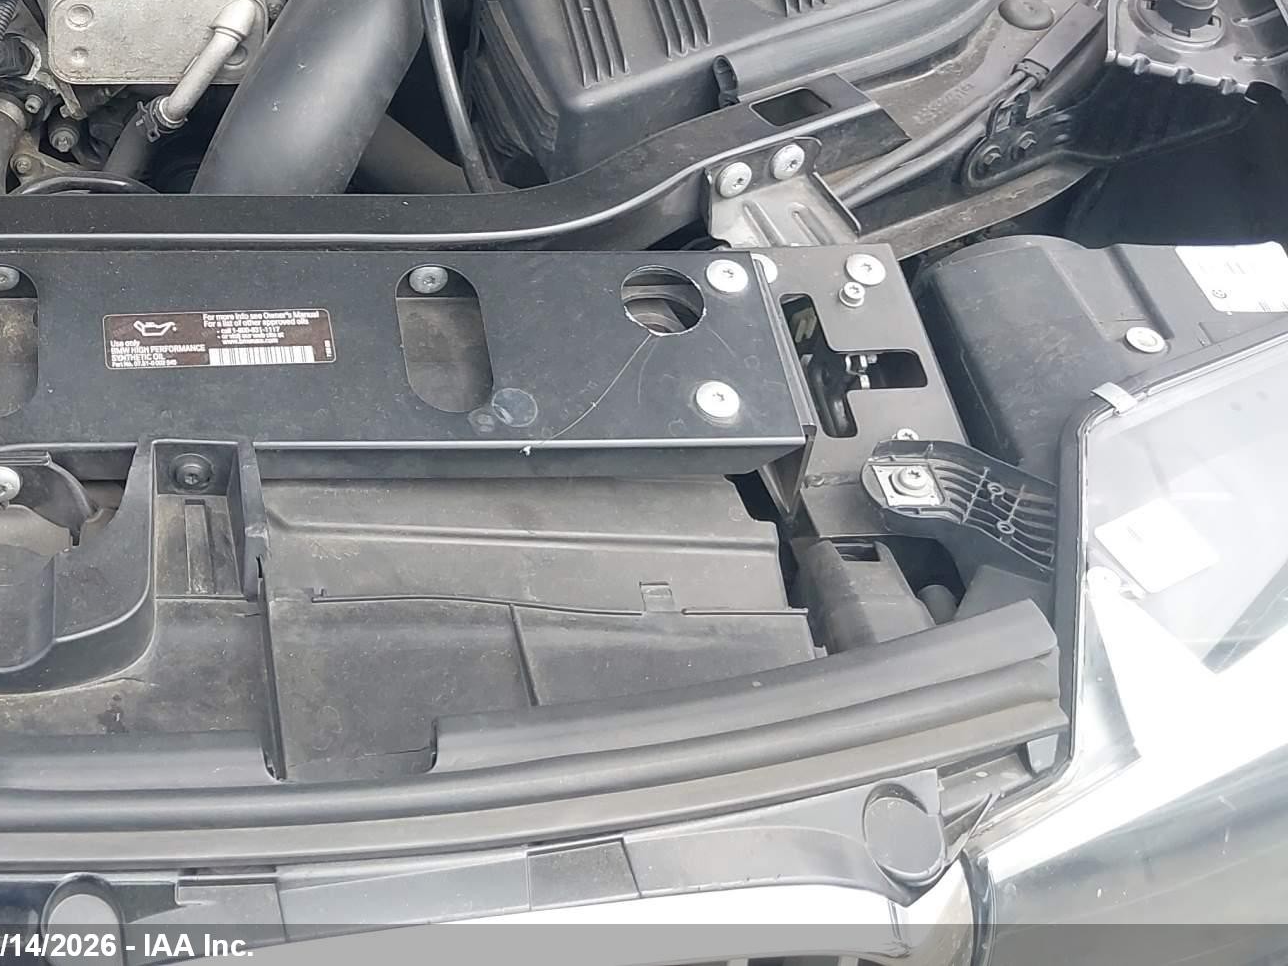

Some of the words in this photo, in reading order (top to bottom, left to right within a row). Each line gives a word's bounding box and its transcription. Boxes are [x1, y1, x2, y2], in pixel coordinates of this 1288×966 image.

[202, 313, 214, 321] For
[263, 311, 292, 319] Owner's
[293, 310, 319, 319] Manual
[243, 319, 261, 327] other
[262, 318, 295, 327] approved
[125, 339, 141, 347] only
[130, 346, 149, 354] HIGH
[150, 344, 206, 353] PERFORMANCE
